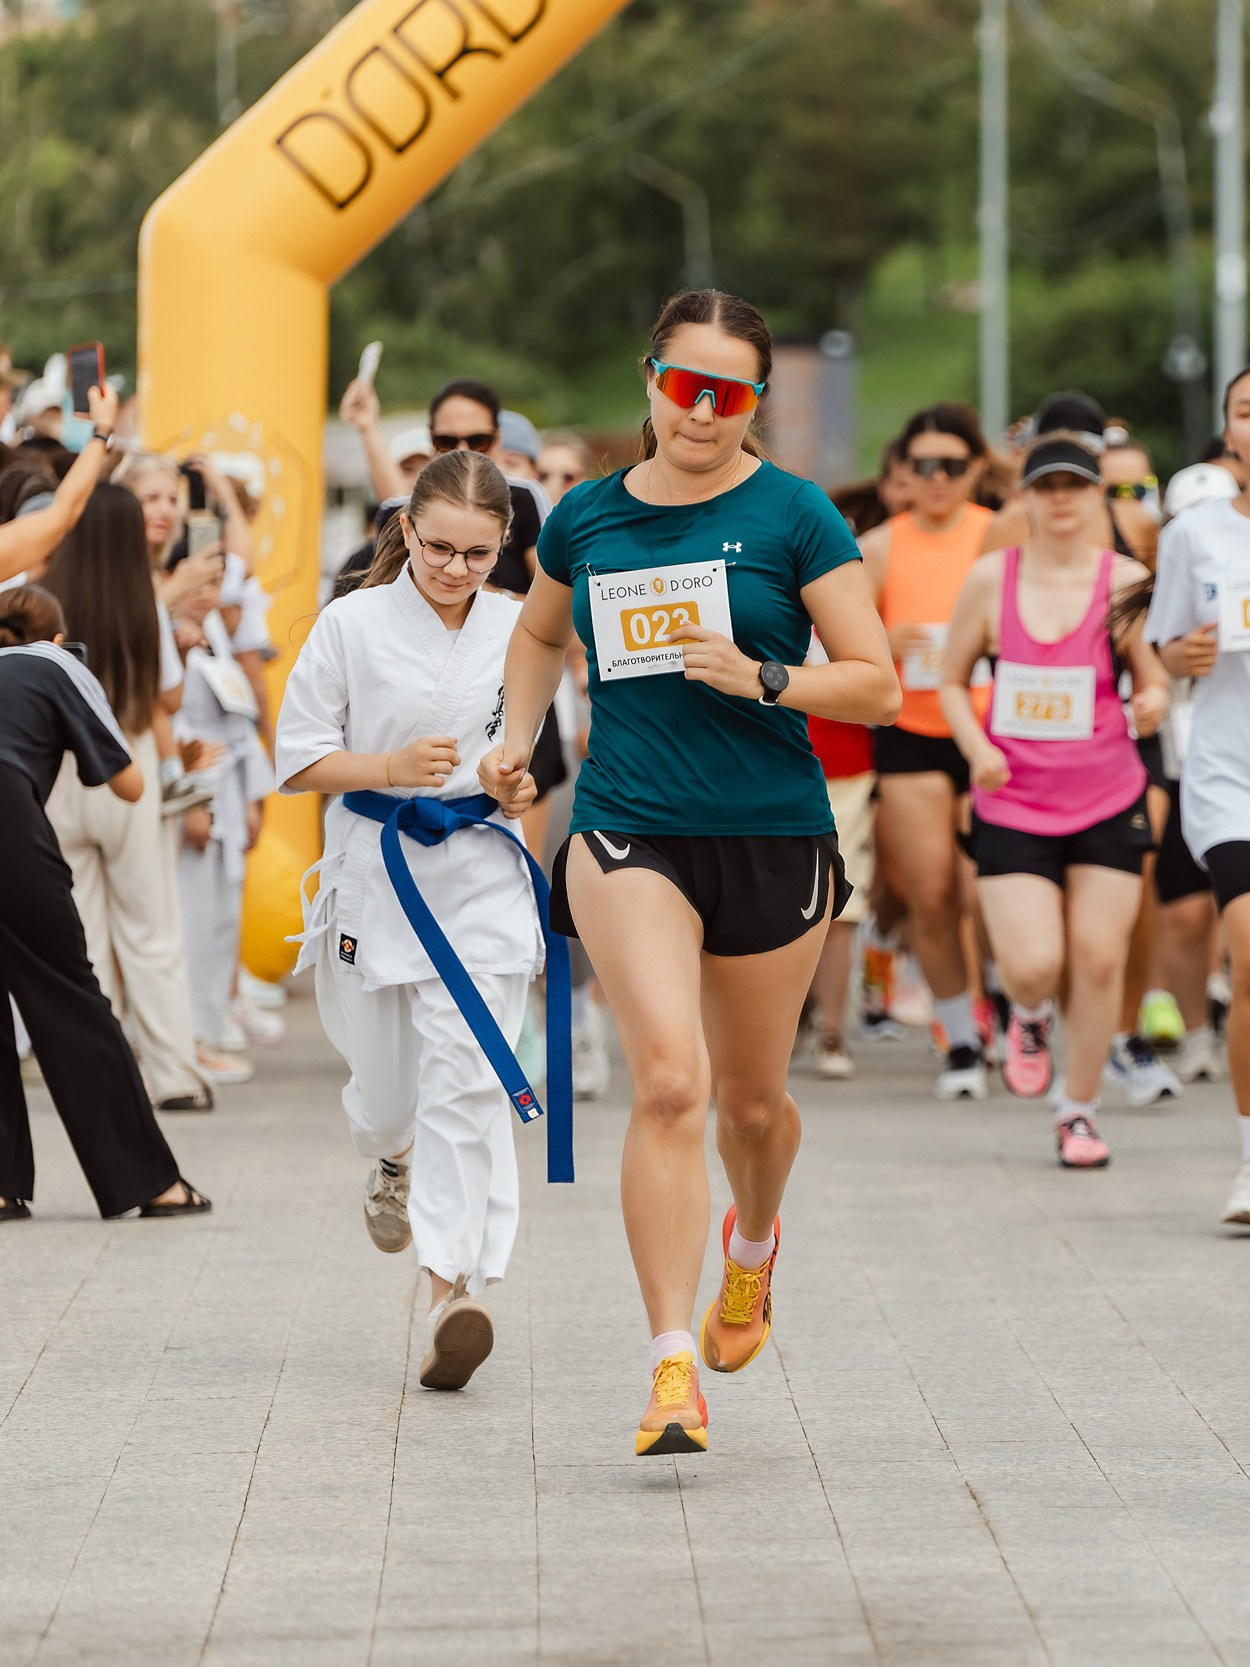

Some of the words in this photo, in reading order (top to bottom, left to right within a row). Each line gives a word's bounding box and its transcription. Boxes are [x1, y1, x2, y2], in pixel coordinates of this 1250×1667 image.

[601, 583, 647, 601] LEONE
[670, 575, 713, 592] D'ORO
[612, 652, 684, 668] БЛАГОТВОРИТЕЛЬН
